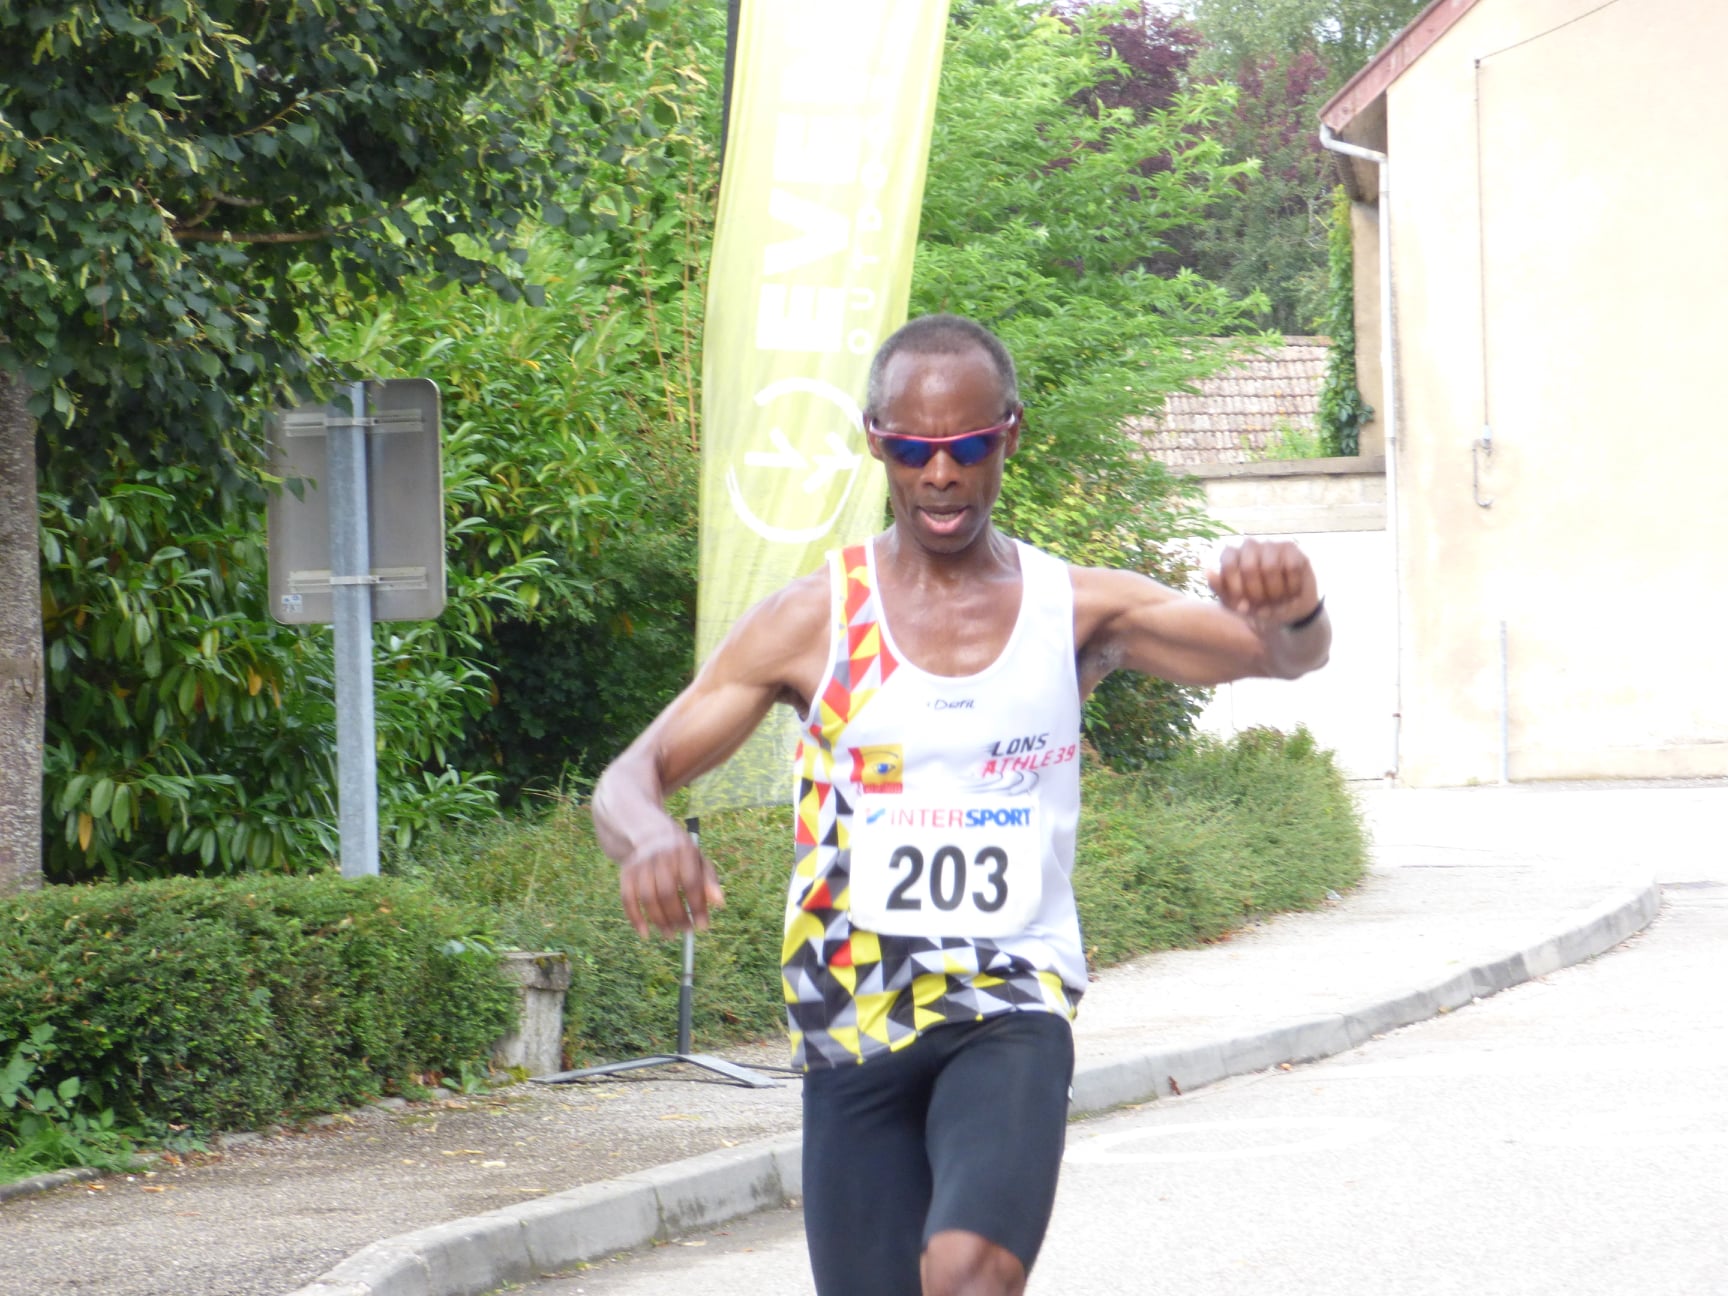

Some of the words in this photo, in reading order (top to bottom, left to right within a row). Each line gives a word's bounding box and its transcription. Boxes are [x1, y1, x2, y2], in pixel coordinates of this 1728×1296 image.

[991, 733, 1050, 757] LONS
[889, 807, 1031, 828] INTERSPORT
[886, 844, 1009, 914] 203
